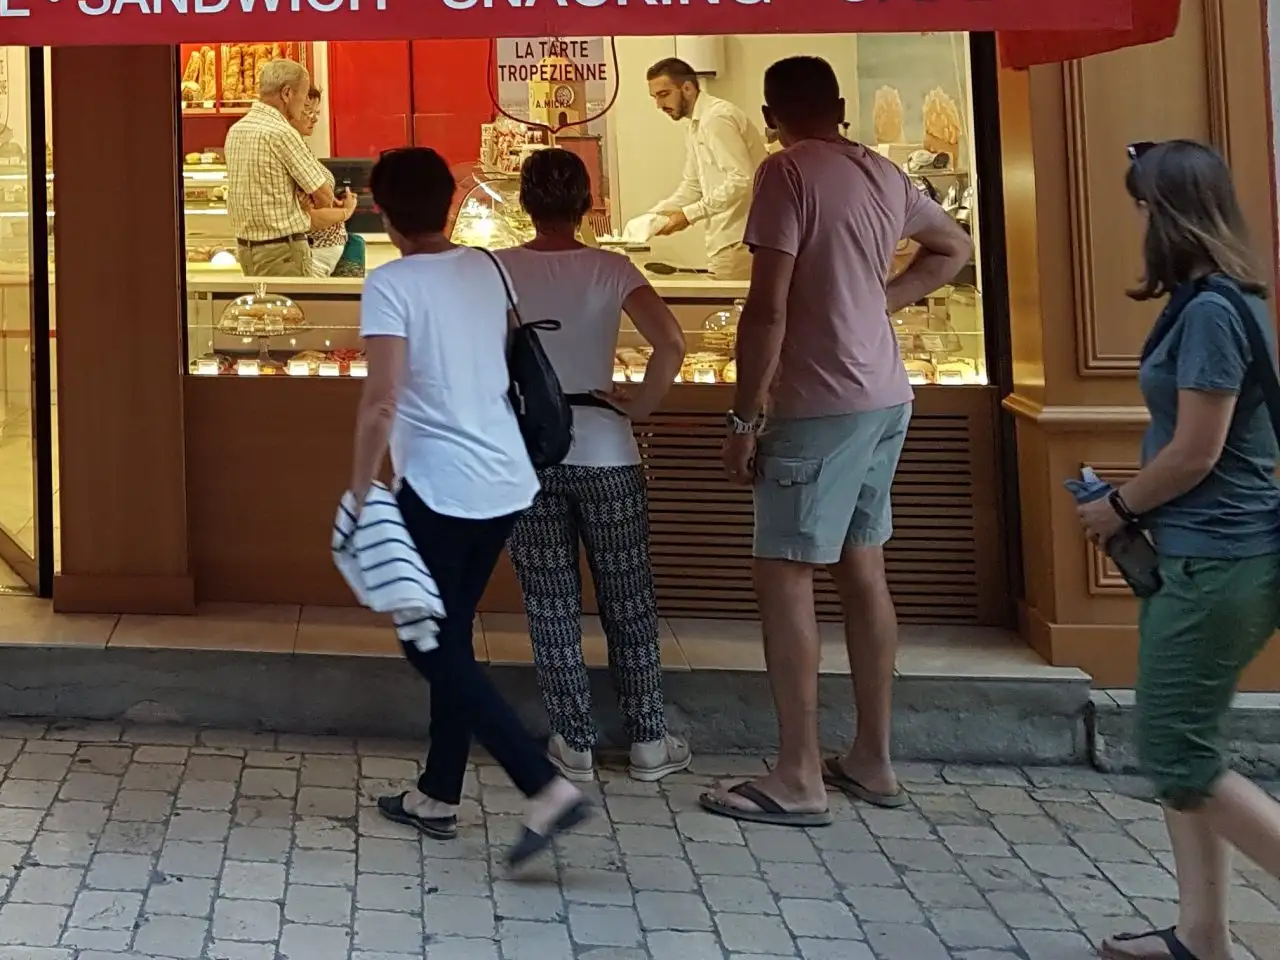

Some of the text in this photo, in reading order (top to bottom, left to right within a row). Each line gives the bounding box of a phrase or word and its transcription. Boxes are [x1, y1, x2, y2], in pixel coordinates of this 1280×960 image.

[515, 40, 589, 59] LA TARTE
[498, 59, 607, 82] TROPÉZIENNE
[535, 100, 571, 109] A.MICKA
